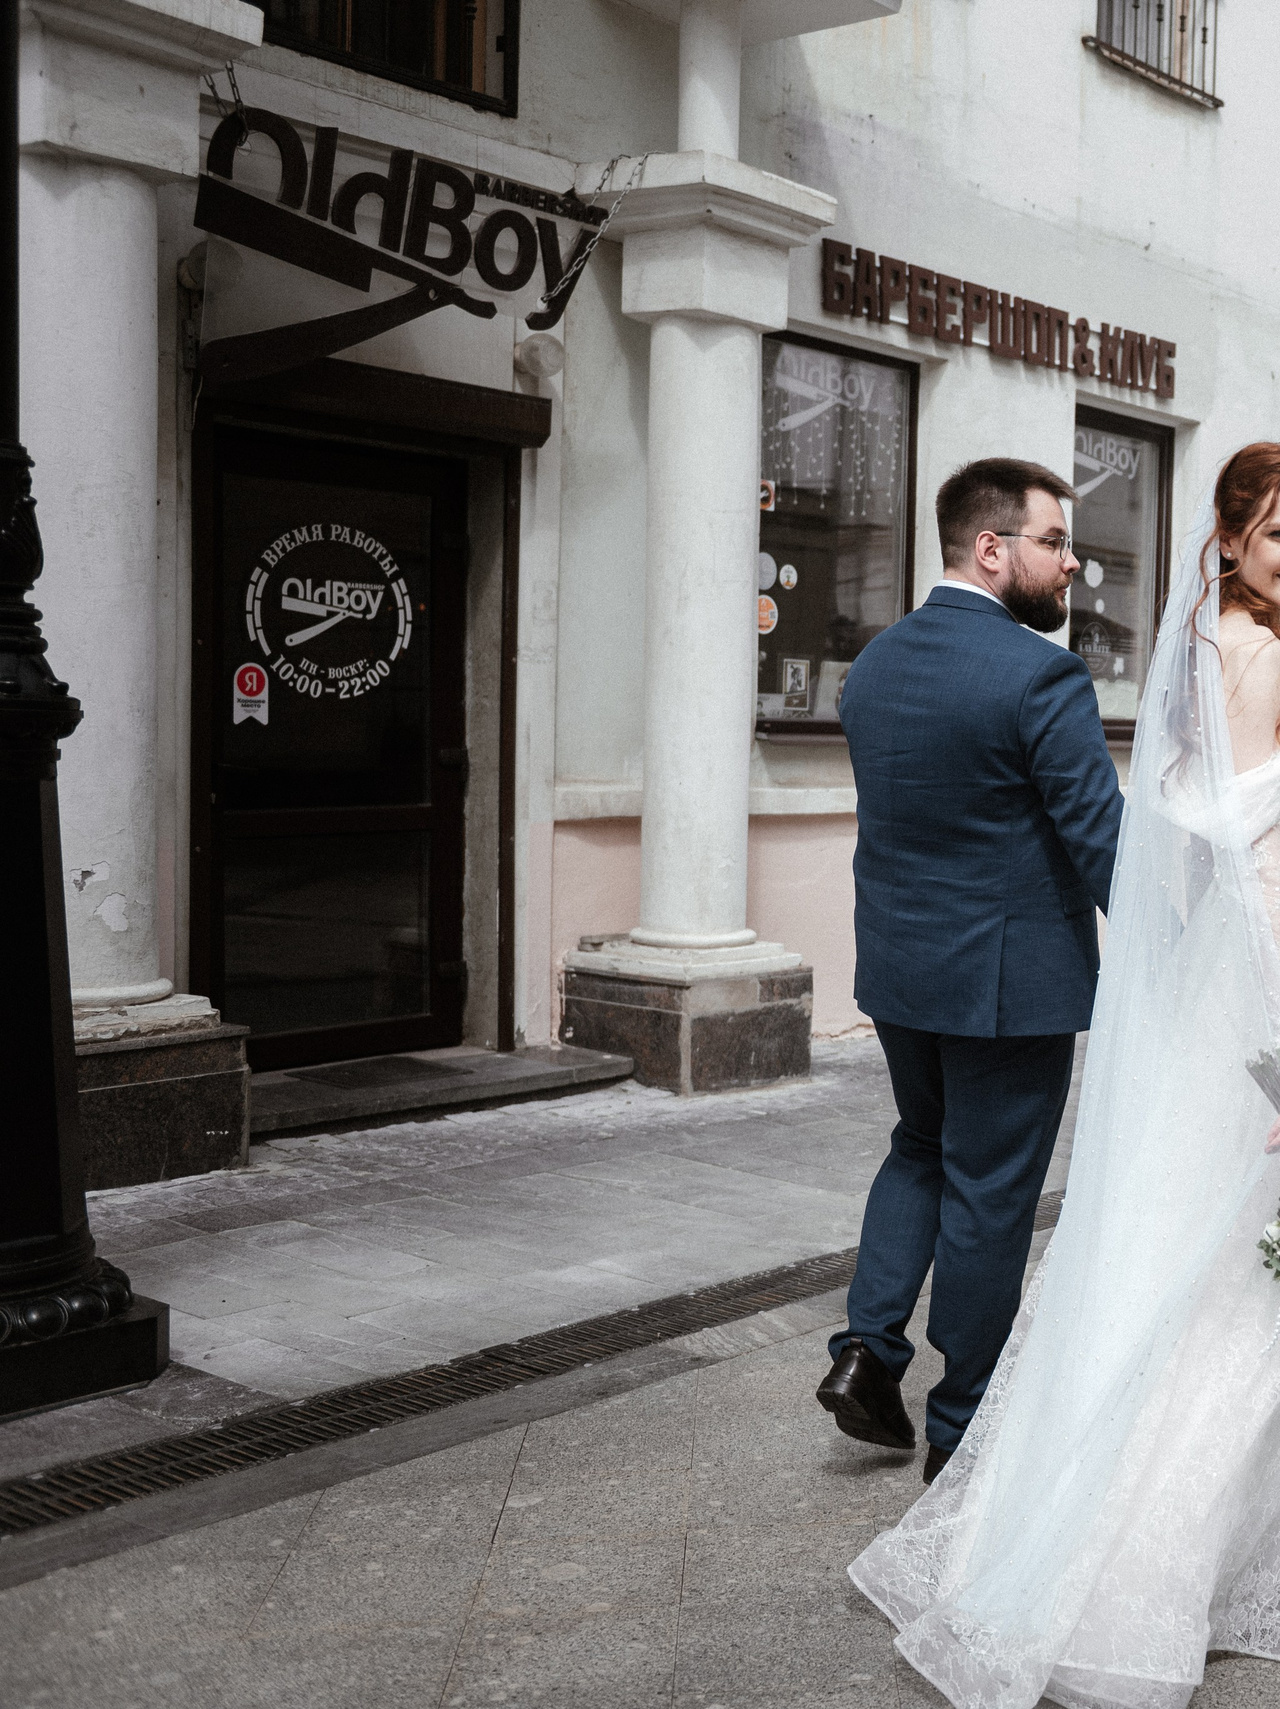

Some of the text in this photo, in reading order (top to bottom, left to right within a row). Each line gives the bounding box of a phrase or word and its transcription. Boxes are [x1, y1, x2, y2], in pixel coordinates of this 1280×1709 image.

[207, 107, 599, 331] OldBoy
[822, 238, 1177, 399] БАРБЕРШОП & КЛУБ
[261, 524, 400, 578] ВРЕМЯ РАБОТЫ
[281, 577, 384, 620] OldBoy
[244, 671, 257, 692] Я
[299, 657, 319, 675] ПН
